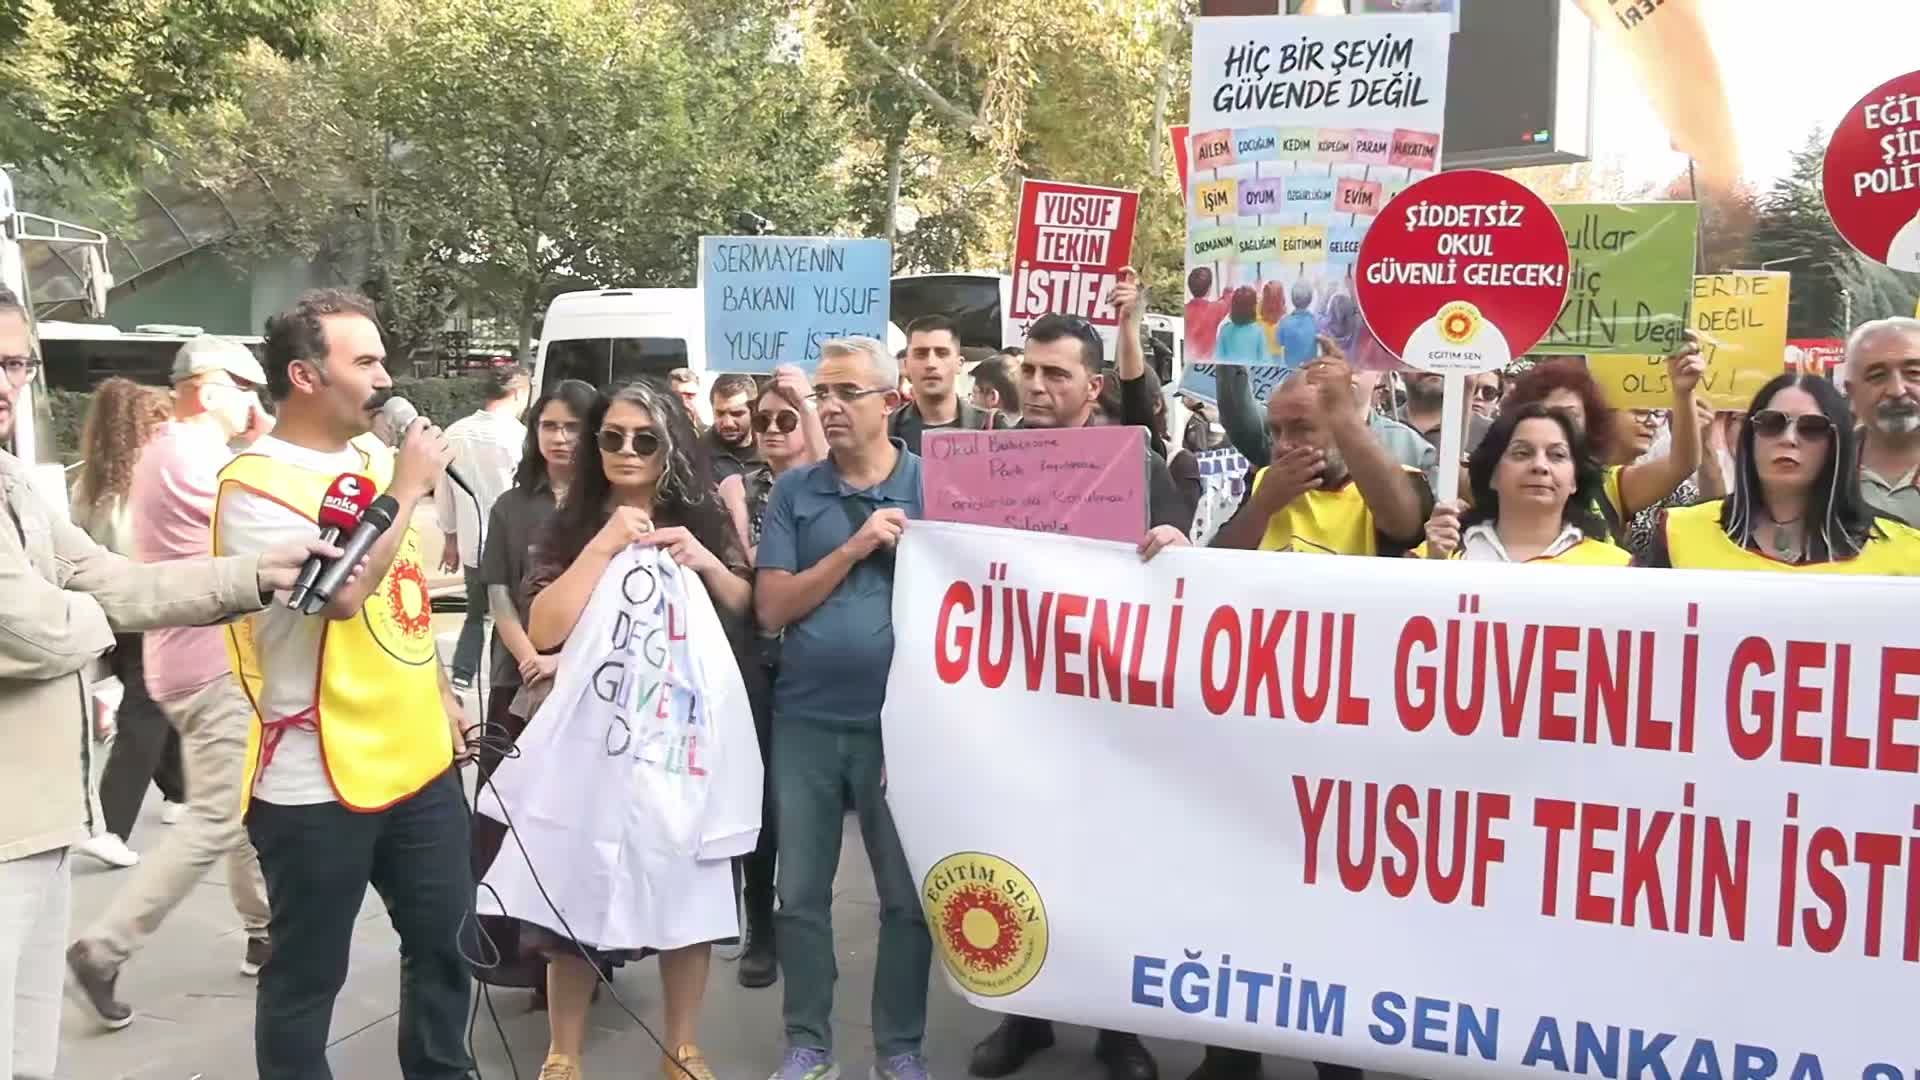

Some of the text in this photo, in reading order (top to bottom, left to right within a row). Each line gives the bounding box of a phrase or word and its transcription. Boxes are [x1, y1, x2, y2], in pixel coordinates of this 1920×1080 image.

[1224, 33, 1413, 80] HİÇ BİR ŞEYİM
[1213, 71, 1429, 113] GÜVENDE DEĞİL
[1198, 139, 1230, 160] AİLEM
[1356, 140, 1387, 154] PARAM
[1044, 195, 1114, 226] YUSUF
[1203, 189, 1228, 211] İŞİM
[1246, 190, 1275, 205] OYUM
[1344, 187, 1373, 206] EVİM
[1405, 200, 1525, 232] ŞİDDETSİZ
[1043, 228, 1105, 263] TEKİN
[1194, 236, 1234, 254] ORMANIM
[1329, 241, 1360, 253] GELECE
[1437, 233, 1493, 256] OKUL
[1566, 214, 1636, 250] ullar
[713, 243, 845, 273] SERMAYENİN
[1366, 257, 1564, 287] GÜVENLİ GELECEK!
[723, 285, 881, 315] BAKANI YUSUF
[1016, 260, 1118, 320] İSTİFA
[1694, 276, 1769, 298] ERDE
[1549, 293, 1617, 344] KİN
[724, 330, 789, 361] YUSUF
[934, 561, 1920, 774] GÜVENLİ OKUL GÜVENLİ GELE
[1291, 775, 1511, 907] YUSUF
[1533, 782, 1751, 942] TEKİN
[927, 862, 1040, 924] EĞİTİM SEN
[1131, 947, 1347, 1037] EĞİTİM
[1368, 991, 1500, 1062] SEN
